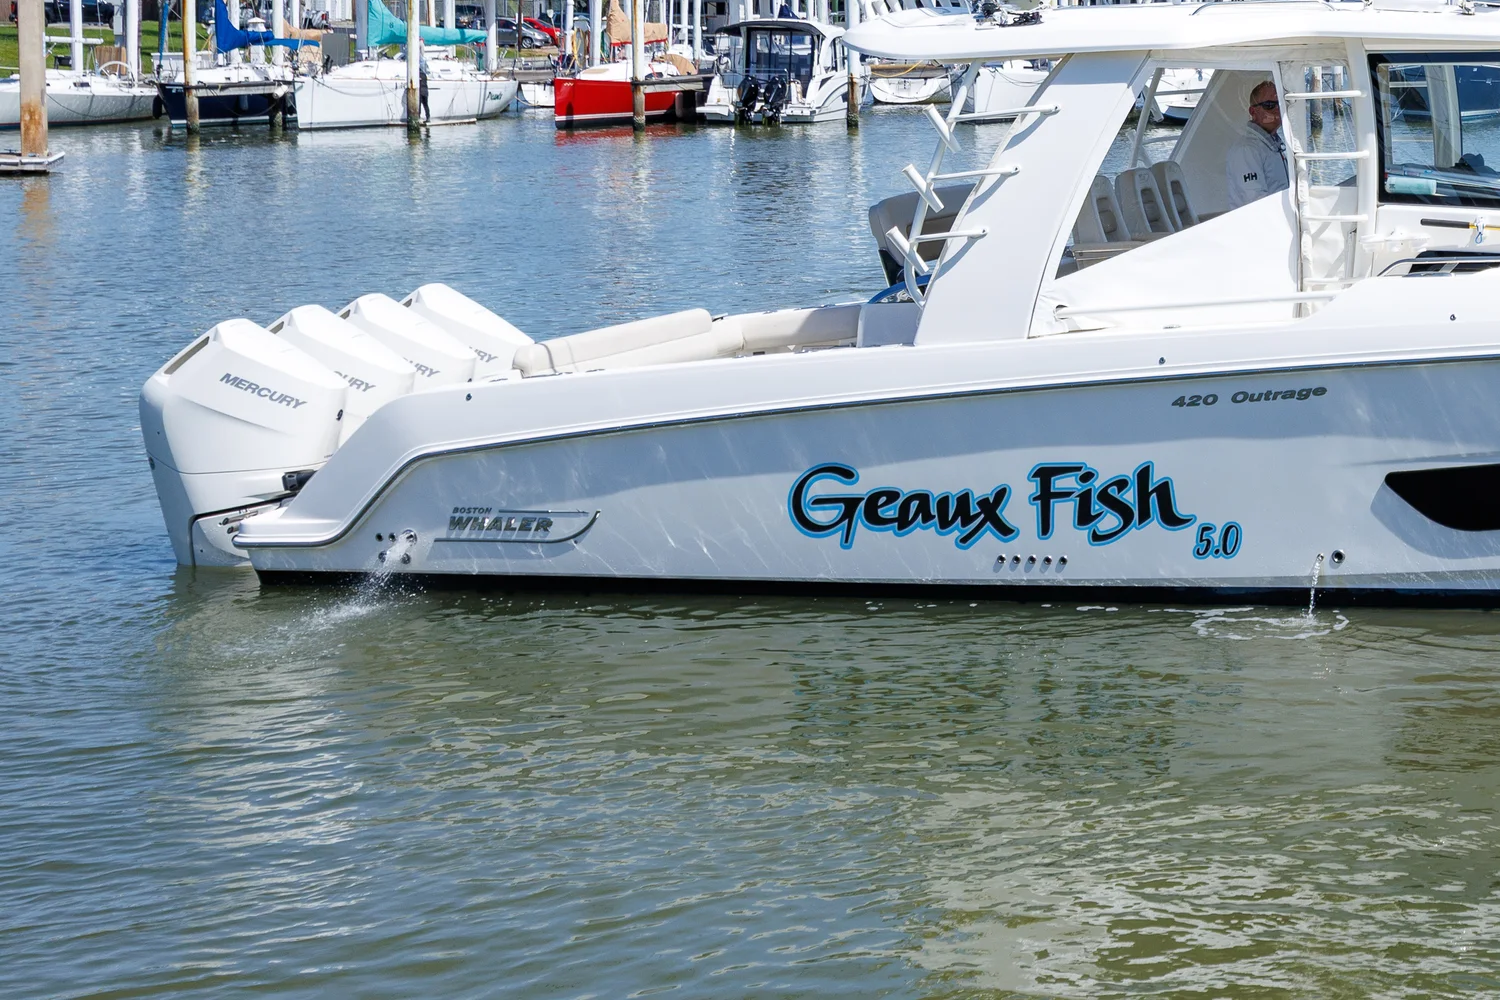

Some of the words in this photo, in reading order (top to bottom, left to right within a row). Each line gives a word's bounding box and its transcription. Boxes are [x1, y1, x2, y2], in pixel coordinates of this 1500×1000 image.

[1243, 172, 1258, 183] HH
[219, 372, 307, 409] MERCURY
[1171, 393, 1219, 408] 420
[1230, 386, 1328, 404] Outrage
[452, 506, 492, 515] BOSTON
[788, 462, 1020, 550] Geaux
[1026, 460, 1197, 546] Fish
[448, 515, 554, 532] WHALER
[1192, 520, 1243, 560] 5.0
